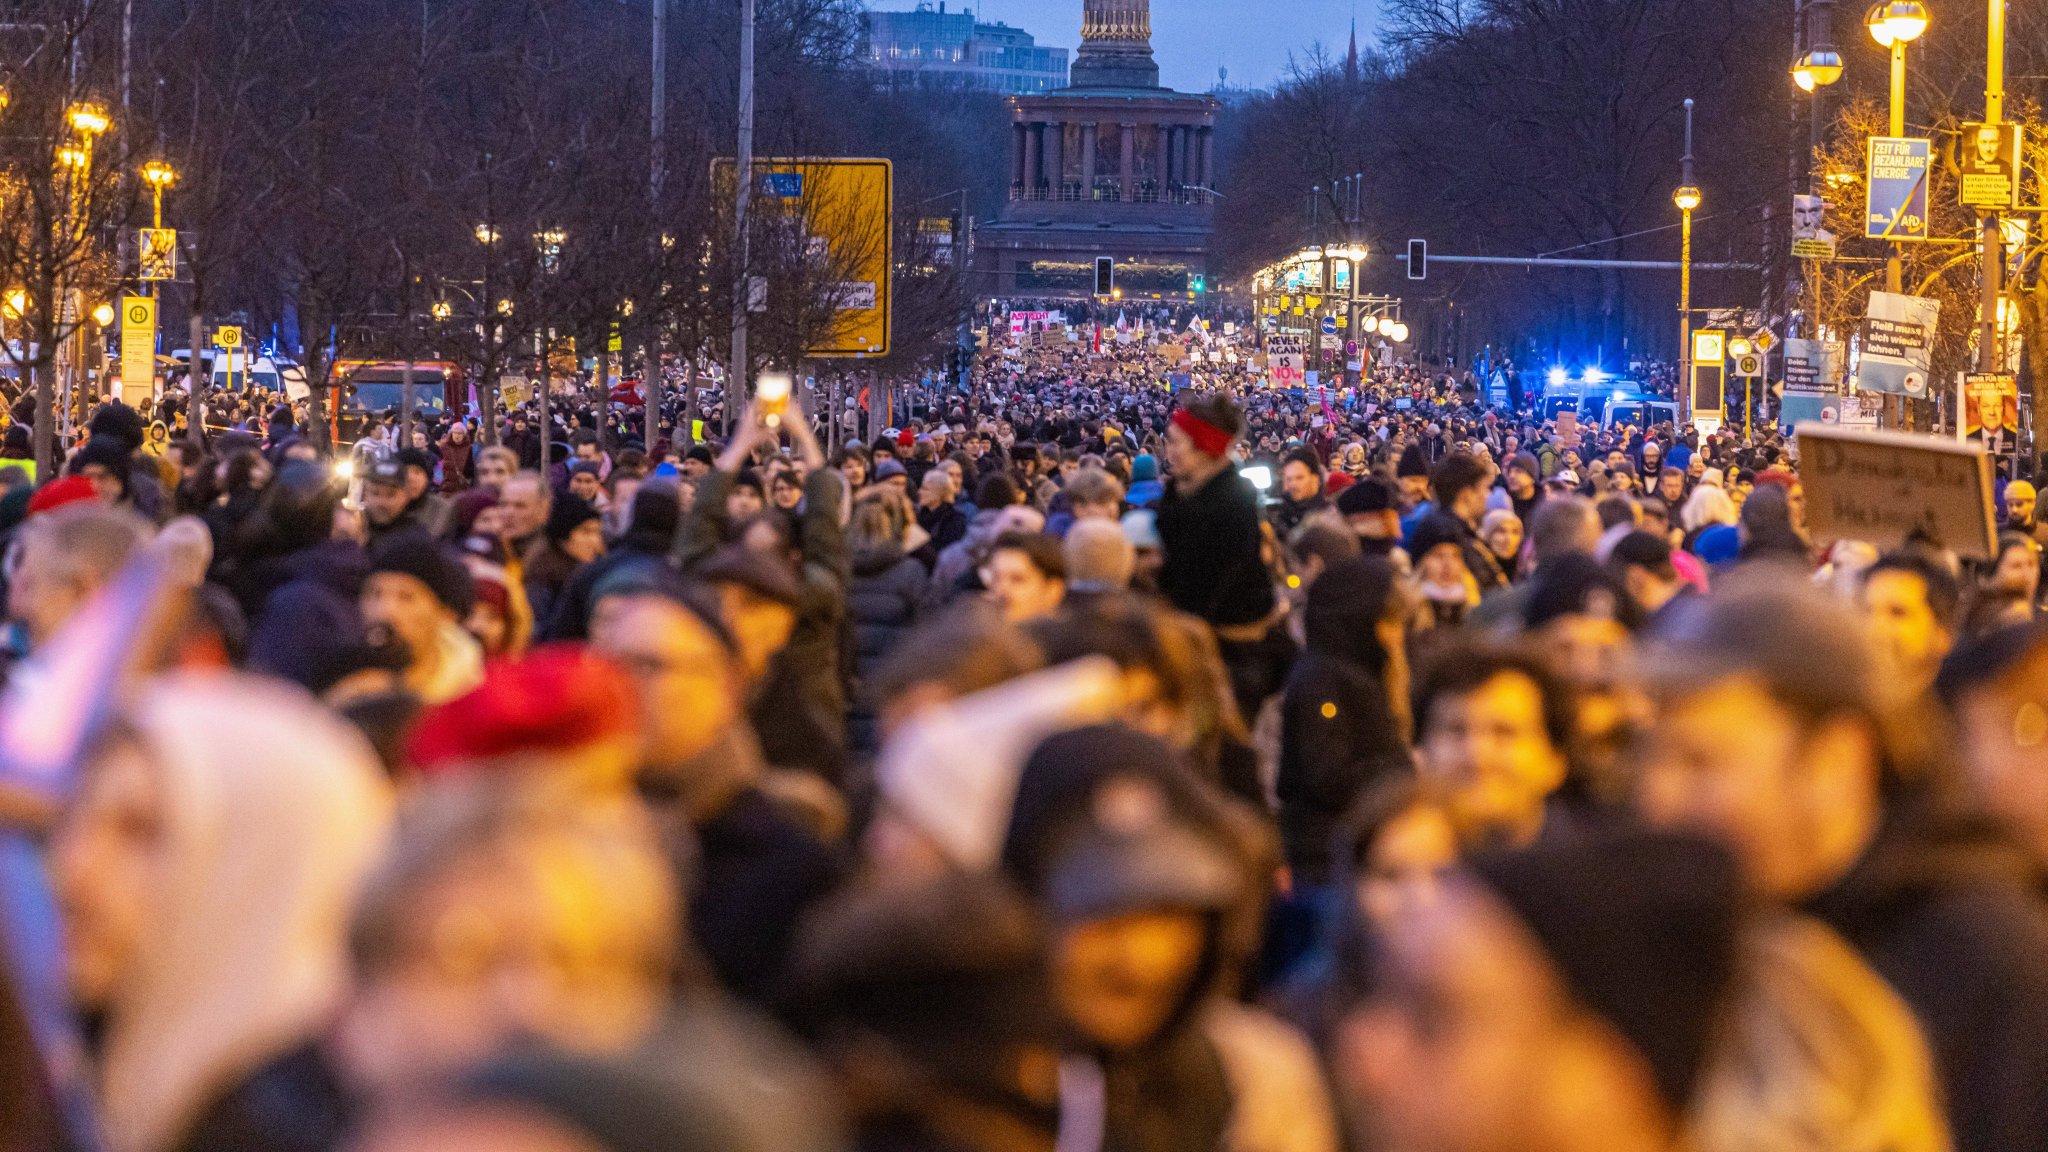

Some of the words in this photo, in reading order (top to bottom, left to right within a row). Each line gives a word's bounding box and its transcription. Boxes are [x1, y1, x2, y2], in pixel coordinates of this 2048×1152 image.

[1874, 143, 1894, 154] ZEIT
[1894, 141, 1910, 155] FÜR
[1874, 154, 1925, 168] BEZAHLBARE
[1873, 167, 1910, 179] ENERGIE.
[1901, 215, 1920, 226] AfD
[1870, 320, 1894, 332] Fleiß
[1895, 325, 1921, 336] muss
[1268, 335, 1300, 345] NEVER
[1869, 332, 1889, 343] sich
[1890, 335, 1922, 347] wieder
[1269, 346, 1302, 355] AGAIN
[1867, 342, 1902, 356] lohnen.
[1280, 356, 1290, 367] IS
[1787, 358, 1807, 366] Beide
[1270, 367, 1303, 380] NOW
